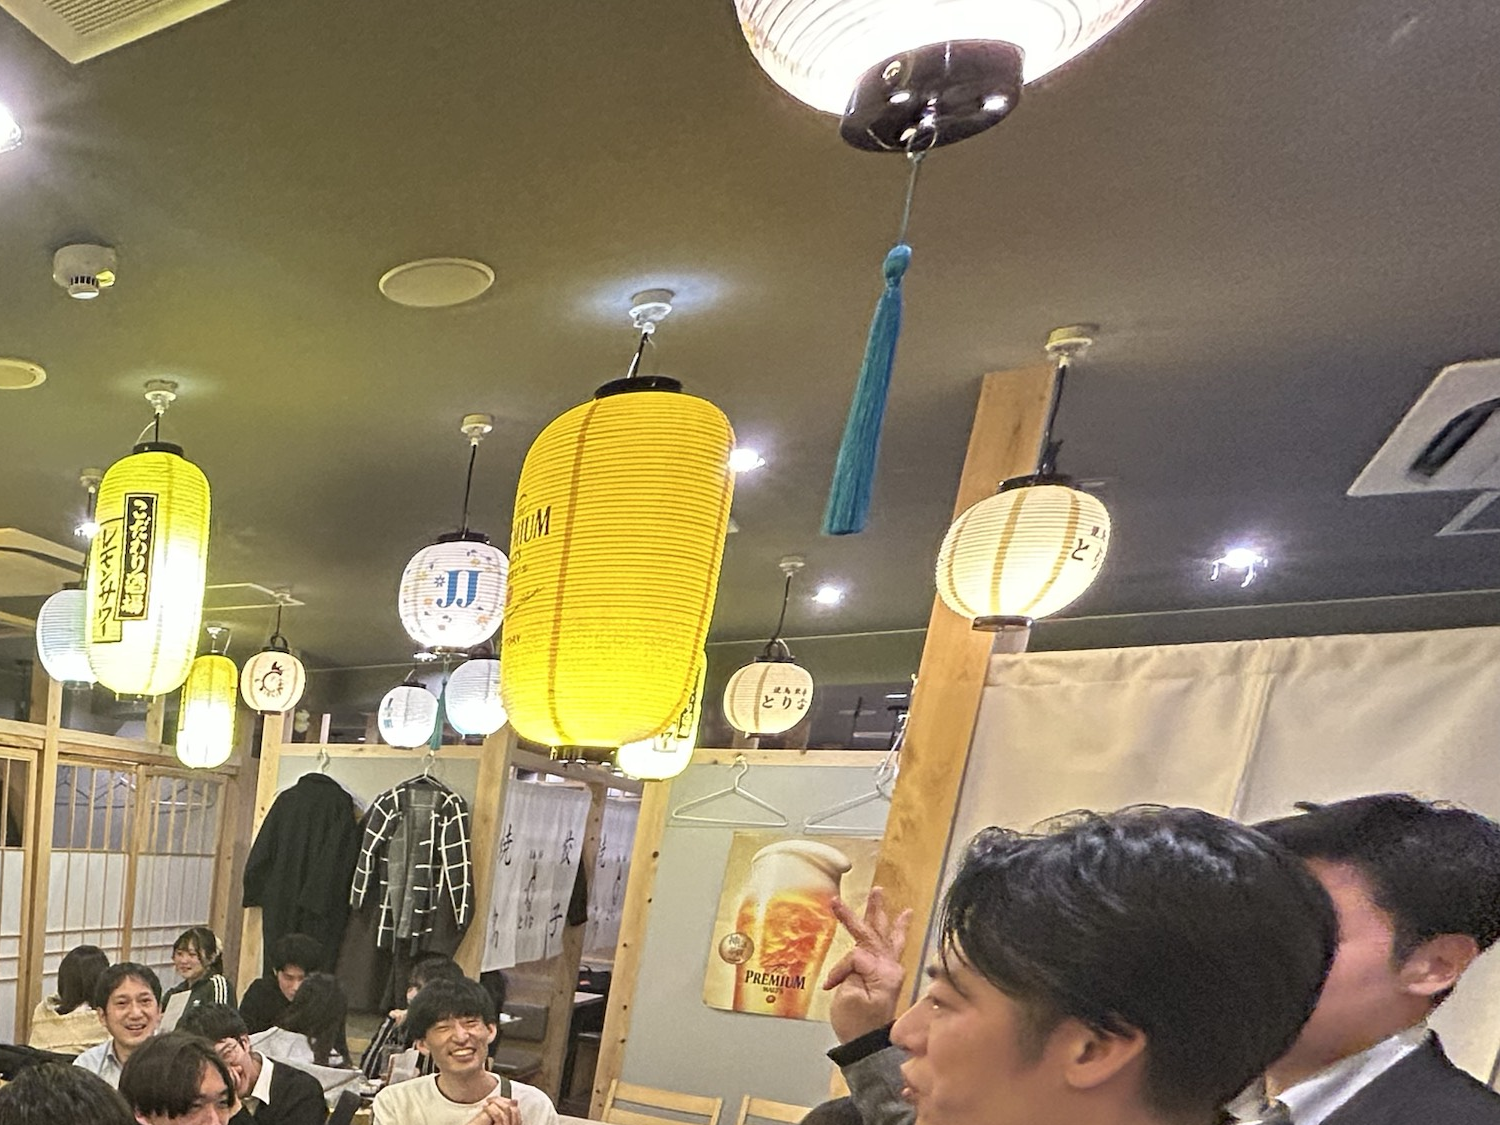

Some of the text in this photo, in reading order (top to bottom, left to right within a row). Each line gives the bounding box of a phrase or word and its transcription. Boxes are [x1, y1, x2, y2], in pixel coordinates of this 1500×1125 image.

[98, 528, 118, 637] レモンサワー
[120, 499, 152, 615] こだわり酒場
[436, 569, 482, 609] JJ
[745, 969, 806, 990] PREMIUM
